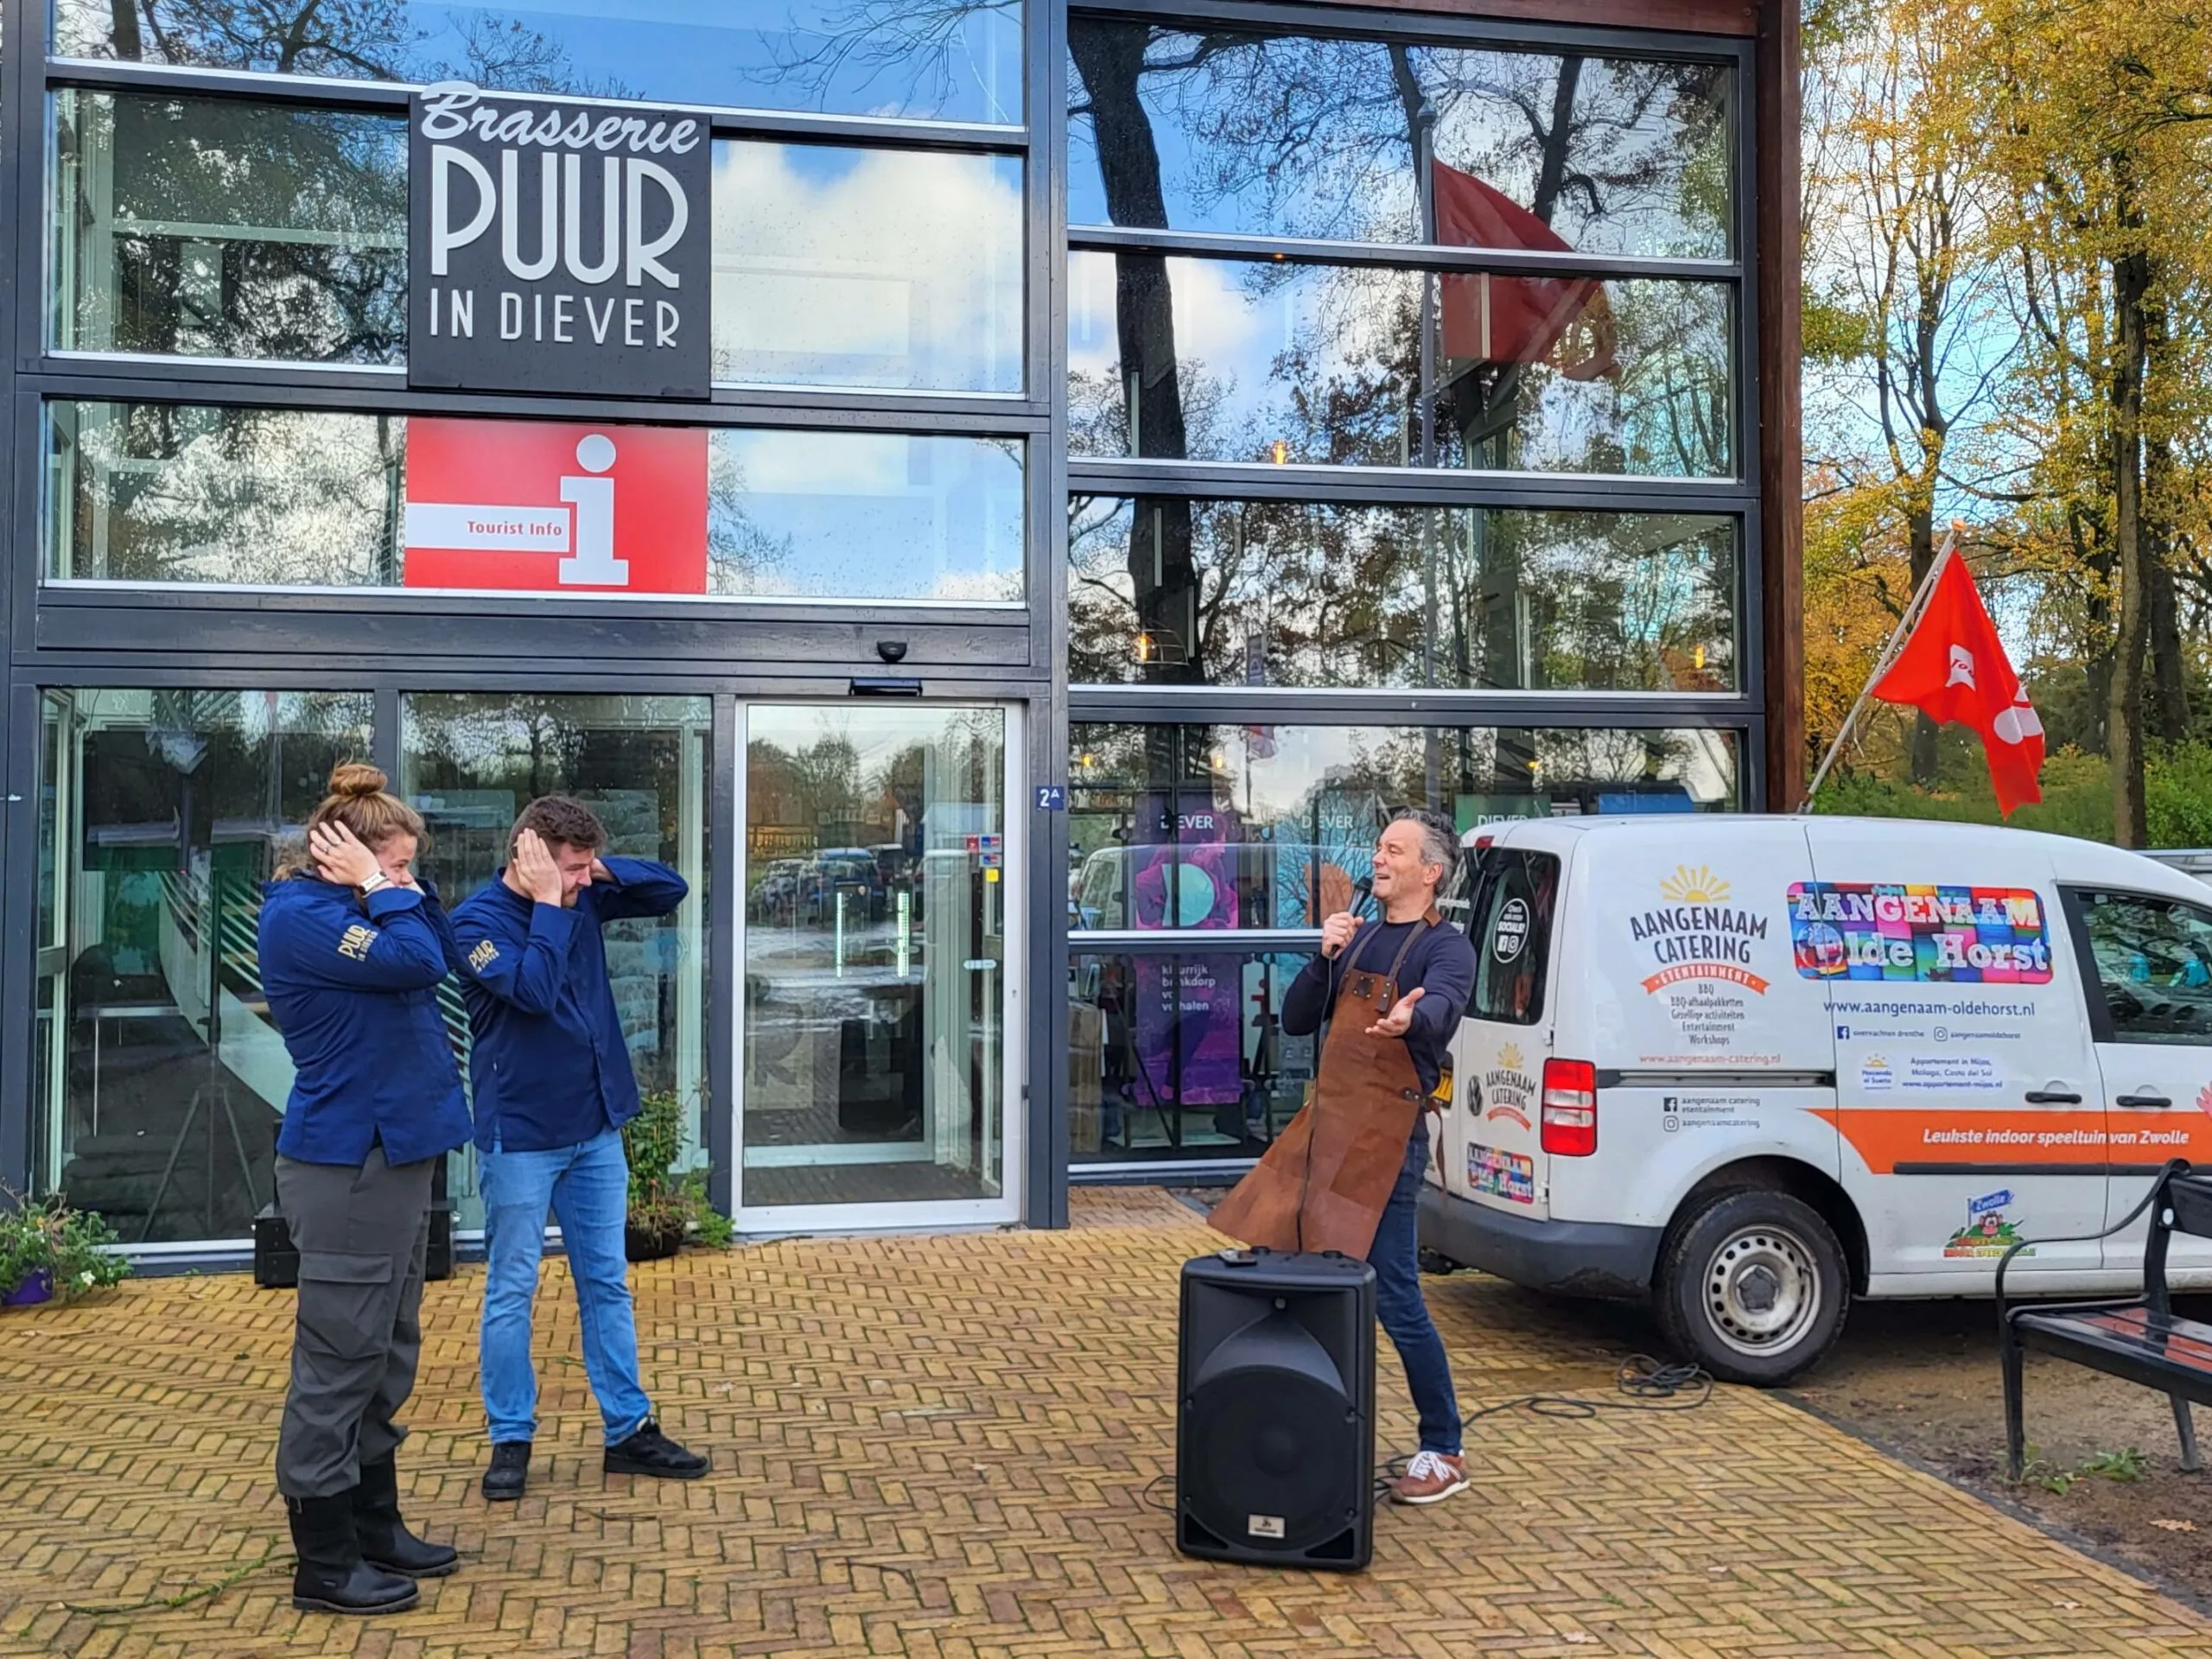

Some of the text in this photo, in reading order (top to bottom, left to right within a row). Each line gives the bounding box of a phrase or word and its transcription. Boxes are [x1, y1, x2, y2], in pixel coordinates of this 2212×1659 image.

[420, 80, 701, 156] Brasserie
[430, 144, 690, 289] PUUR
[430, 288, 681, 348] IN DIEVER
[467, 520, 563, 536] Tourist Info
[1301, 815, 1354, 830] DEVER
[1795, 892, 2041, 927] AANGENAAM
[1630, 906, 1768, 942] AANGENAAM
[338, 925, 371, 959] PUUR
[1654, 934, 1751, 964] CATERING
[1931, 933, 2050, 970] Horst
[1698, 983, 1714, 995] BBQ
[1823, 1001, 2036, 1018] www.aangenaam-oldehorst.nl
[1681, 1022, 1736, 1033] Entertainment
[1688, 1035, 1730, 1046] Workshops
[1639, 1052, 1782, 1065] www.aangenaam-catering.nl
[1923, 1128, 2190, 1147] Leukste indoor speeltuin van Zwolle
